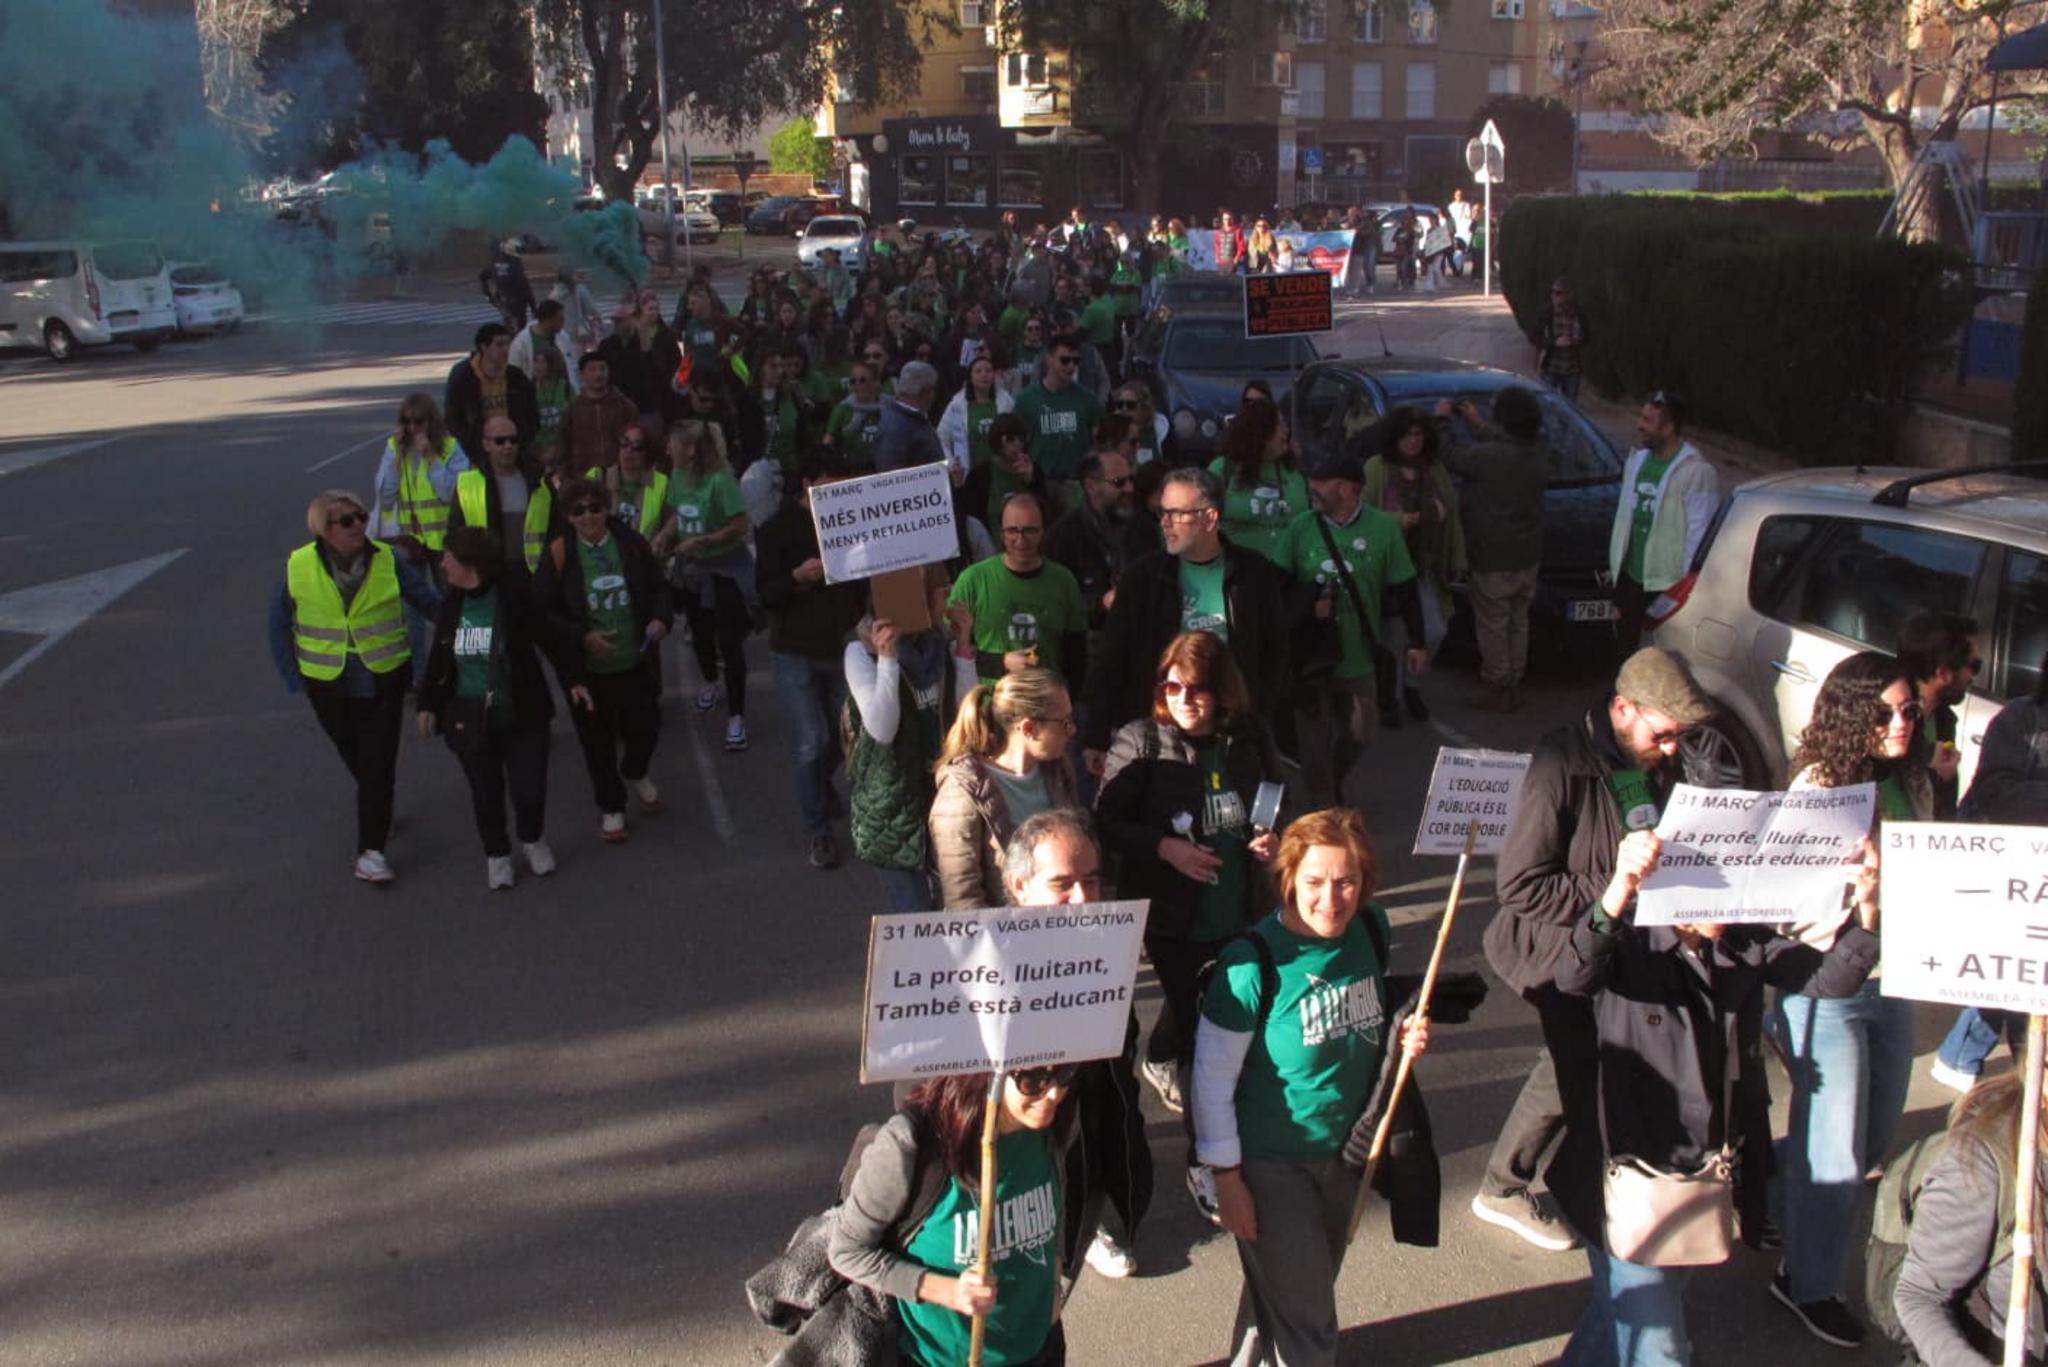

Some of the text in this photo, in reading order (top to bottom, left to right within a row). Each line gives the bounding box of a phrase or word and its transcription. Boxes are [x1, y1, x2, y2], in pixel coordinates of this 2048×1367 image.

[1248, 274, 1329, 297] SE VENDE
[831, 483, 863, 498] MARÇ
[870, 477, 894, 489] VAGA
[820, 490, 948, 531] MÉS INVERSIÓ,
[823, 512, 951, 551] MENYS RETALLADES
[1448, 778, 1510, 793] L'EDUCACIÓ
[1437, 798, 1481, 815] PÚBLICA
[1496, 802, 1508, 815] EL
[1677, 793, 1697, 806] 31
[1702, 795, 1757, 810] MARÇ
[1805, 794, 1867, 810] EDUCATIVA
[1428, 822, 1451, 835] COR
[1475, 823, 1508, 837] OBLE
[1673, 830, 1697, 843] La
[1890, 832, 1916, 849] 31
[1927, 834, 2007, 854] MARÇ
[883, 912, 1135, 941] 31 MARÇ VAGA EDUCATIVA
[893, 956, 1110, 990] La profe, lluitant,
[1956, 953, 2048, 986] ATE
[875, 985, 1127, 1021] També està educant
[1299, 994, 1325, 1036] LA
[913, 1058, 979, 1073] ASSEMBLEA
[993, 1181, 1056, 1252] LENGUA
